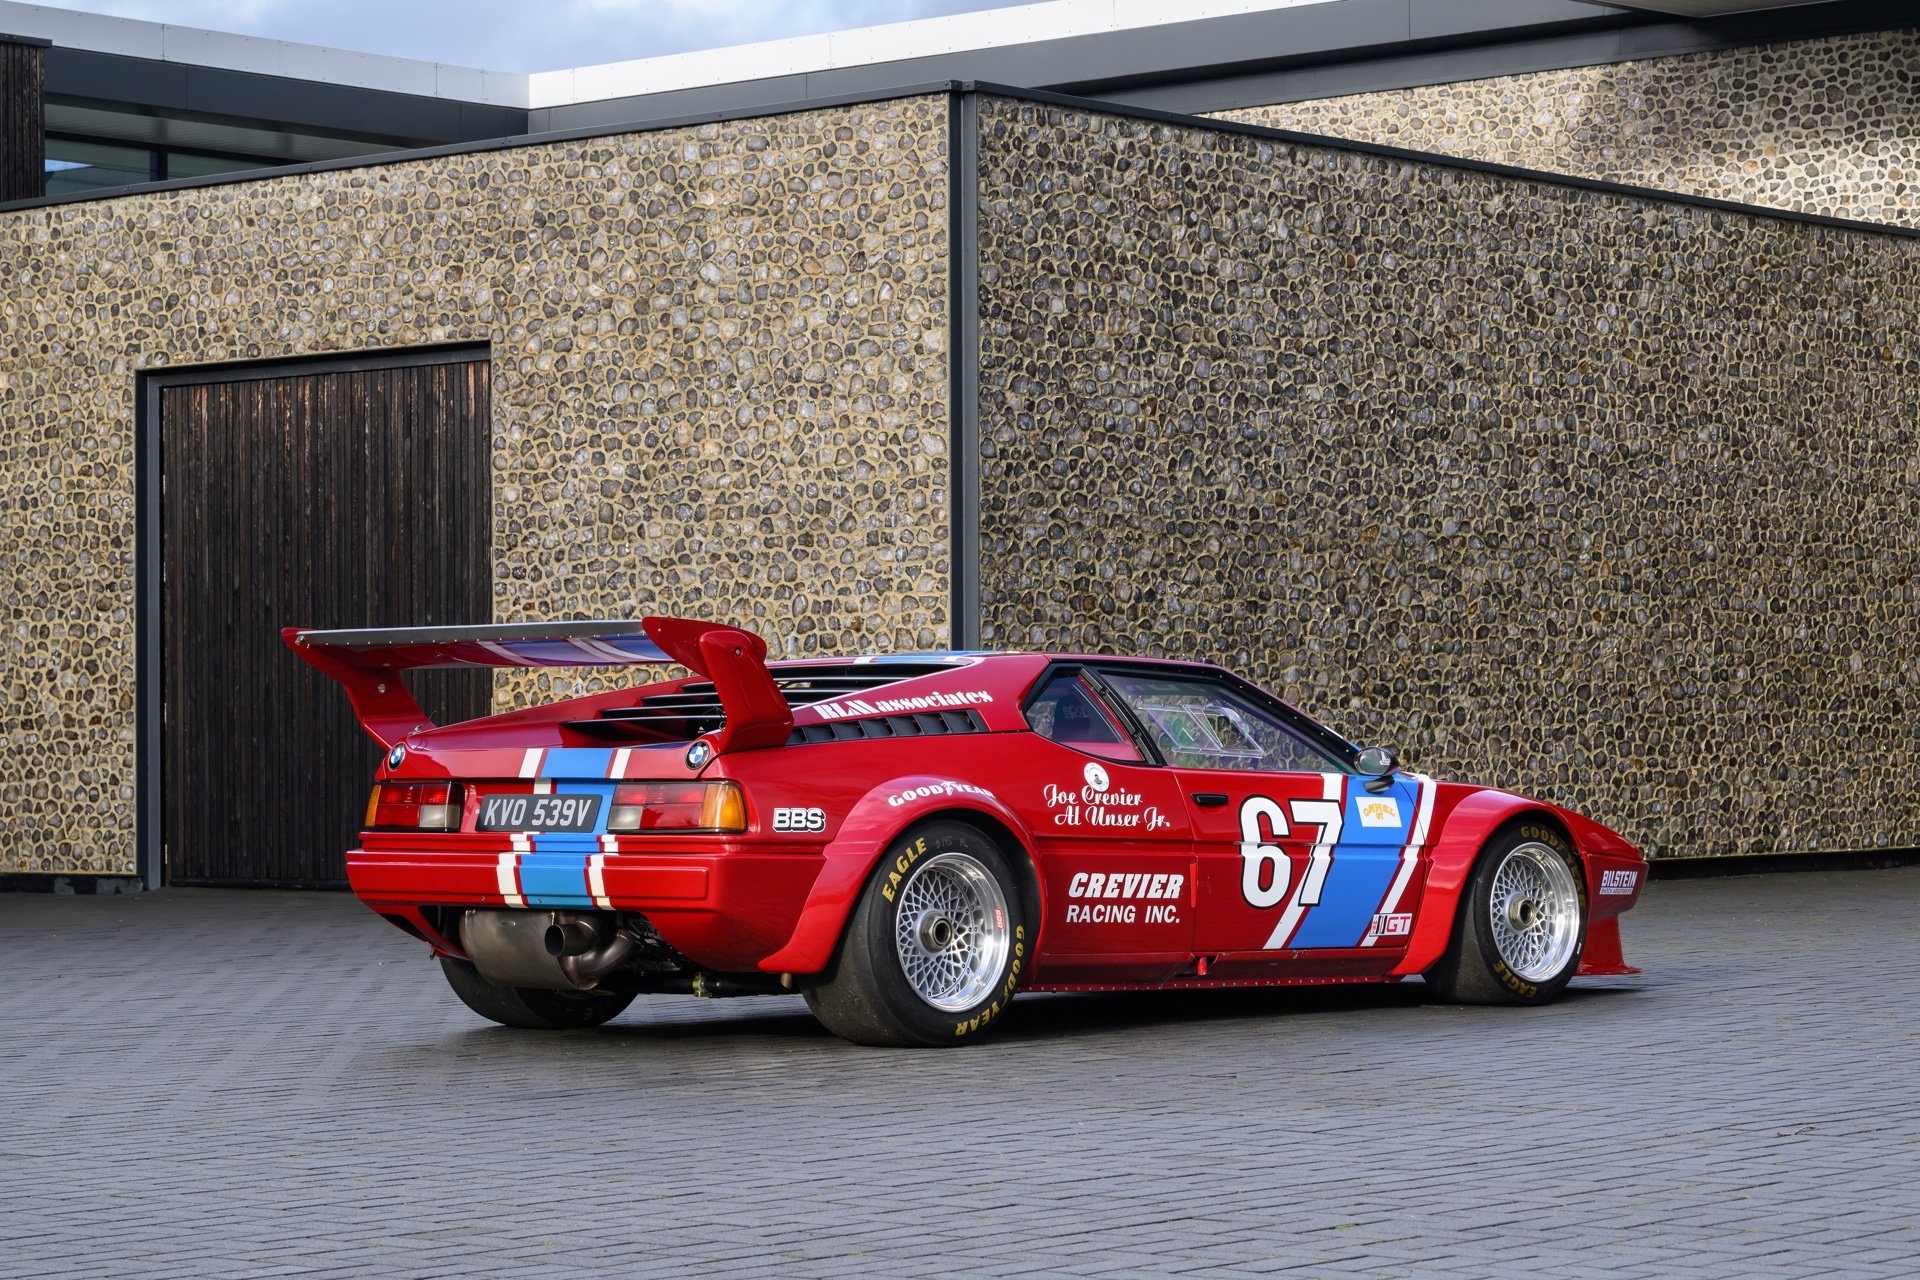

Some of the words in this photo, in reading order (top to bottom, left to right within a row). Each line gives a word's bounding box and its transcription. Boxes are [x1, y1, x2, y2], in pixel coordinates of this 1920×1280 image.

[876, 690, 993, 713] associates
[1043, 783, 1078, 808] Joe
[1081, 785, 1143, 806] Crevier
[483, 798, 527, 826] KVO
[531, 798, 592, 827] 539V
[772, 807, 827, 833] BBS
[1054, 804, 1082, 826] Al
[1084, 805, 1141, 827] Unser
[1143, 806, 1171, 832] Jr.
[1238, 794, 1345, 910] 67
[881, 837, 928, 903] EAGLE
[1601, 870, 1639, 888] BILSTEIN
[1068, 872, 1185, 899] CREVIER
[1066, 905, 1137, 924] RACING
[1144, 905, 1181, 924] INC.
[1386, 915, 1411, 933] GT
[955, 925, 1025, 1036] GOODYEAR
[1492, 960, 1538, 998] EAGLE
